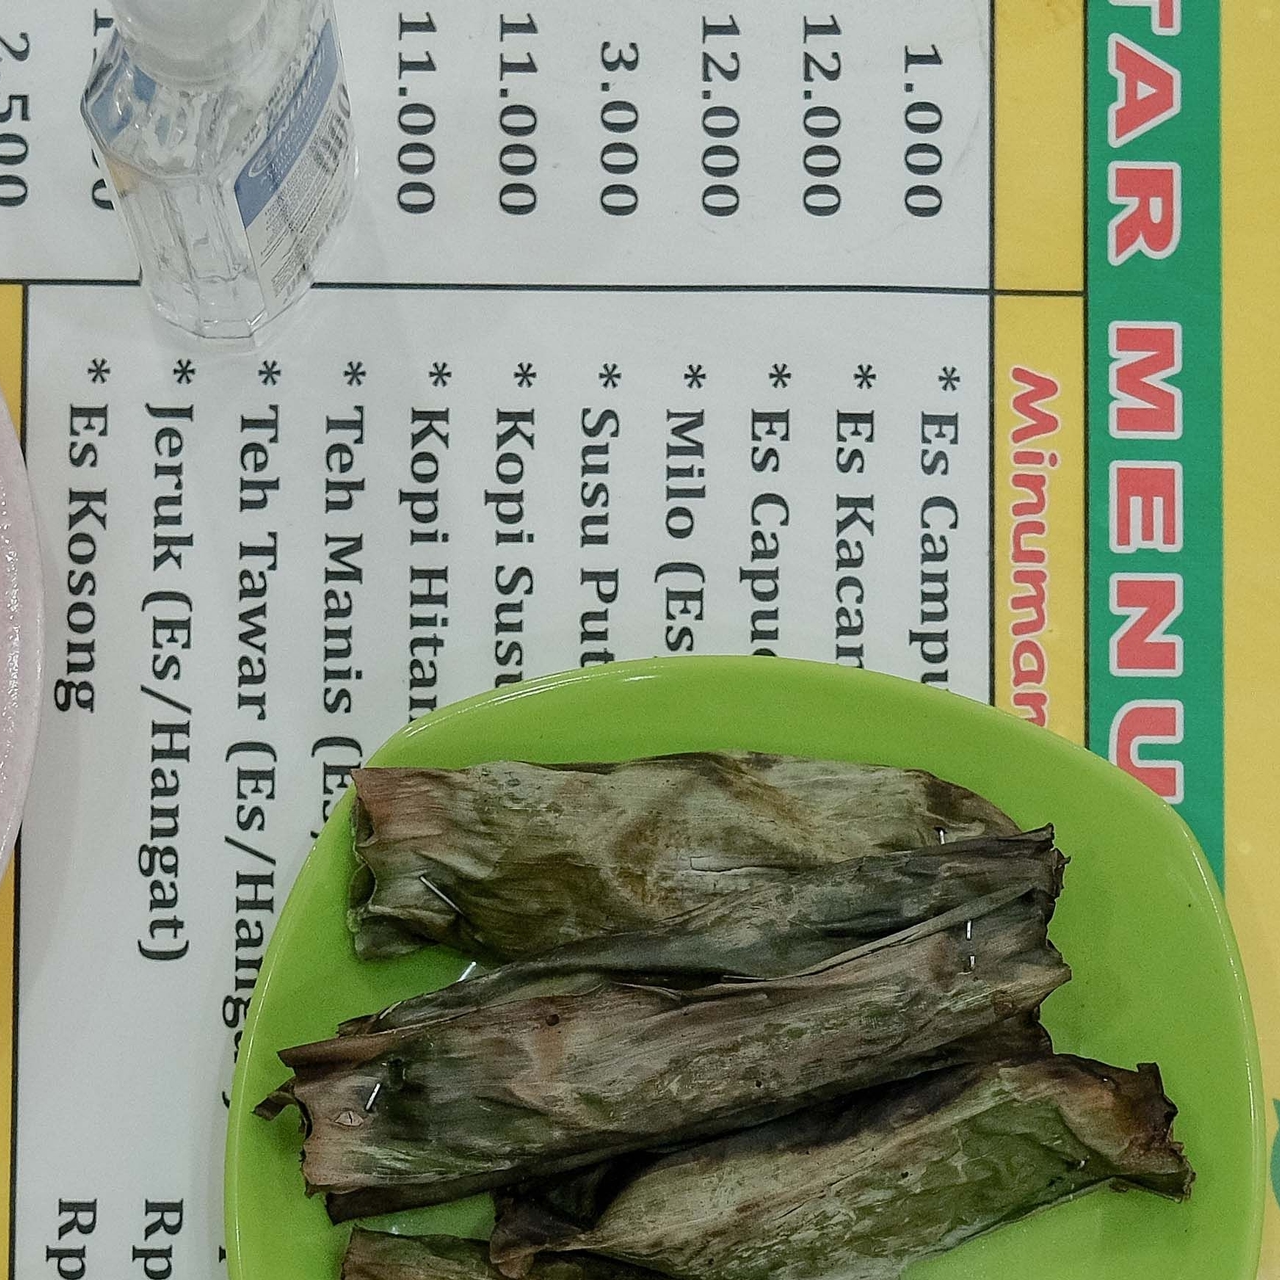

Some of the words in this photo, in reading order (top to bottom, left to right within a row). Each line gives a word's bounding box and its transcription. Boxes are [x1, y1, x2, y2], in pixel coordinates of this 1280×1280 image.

[396, 11, 438, 215] 11.000
[498, 12, 539, 216] 11.000
[599, 40, 640, 217] 3.000
[700, 14, 741, 218] 12.000
[802, 14, 843, 217] 12.000
[903, 43, 944, 218] 1.000
[68, 403, 109, 468] Es
[144, 402, 195, 572] Jeruk
[238, 403, 281, 513] Teh
[324, 404, 366, 515] Teh
[397, 406, 450, 547] Kopi
[483, 407, 536, 547] Kopi
[579, 407, 620, 549] Susu
[664, 408, 707, 540] Milo
[750, 408, 791, 474] Es
[835, 408, 875, 474] Es
[920, 410, 959, 476] Es
[53, 487, 108, 714] Kosong
[237, 531, 278, 721] Tawar
[322, 532, 364, 715] Manis
[579, 568, 619, 668] Put
[1114, 326, 1177, 803] MENU
[136, 590, 193, 962] (Es/Hangat)
[311, 736, 362, 839] (E
[222, 741, 277, 1108] (Es/Hang
